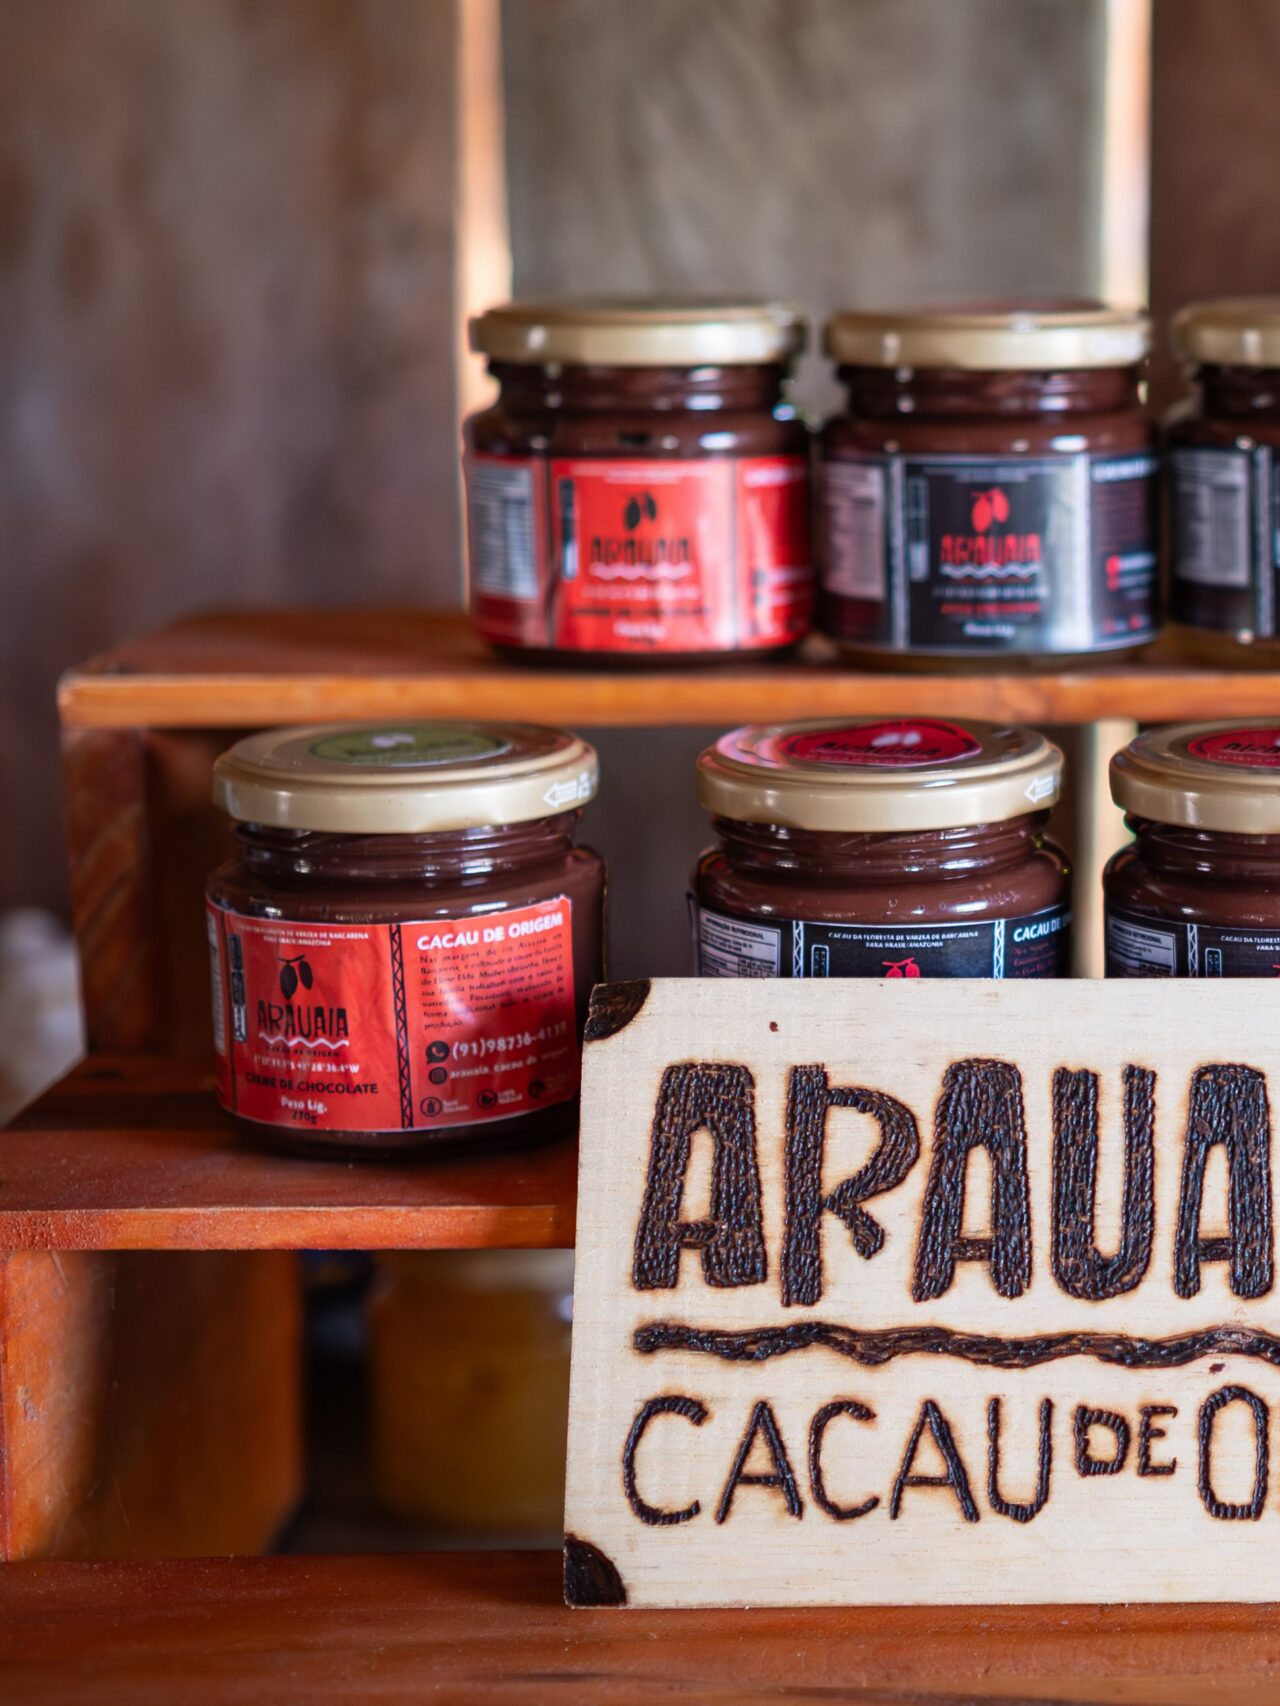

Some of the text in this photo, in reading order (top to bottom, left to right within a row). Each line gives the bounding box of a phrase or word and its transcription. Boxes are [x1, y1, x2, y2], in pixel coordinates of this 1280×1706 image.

[416, 912, 564, 951] CACAU DE ORIGEM
[1013, 921, 1050, 942] CACAU
[1051, 917, 1061, 932] DE
[1220, 935, 1243, 943] CACAU
[257, 1000, 349, 1039] ARAUAIA
[279, 1079, 294, 1090] DE
[297, 1080, 378, 1095] CHOCOLATE
[281, 1096, 306, 1110] Peso
[620, 1395, 1054, 1526] CACAU
[1073, 1404, 1179, 1478] DE
